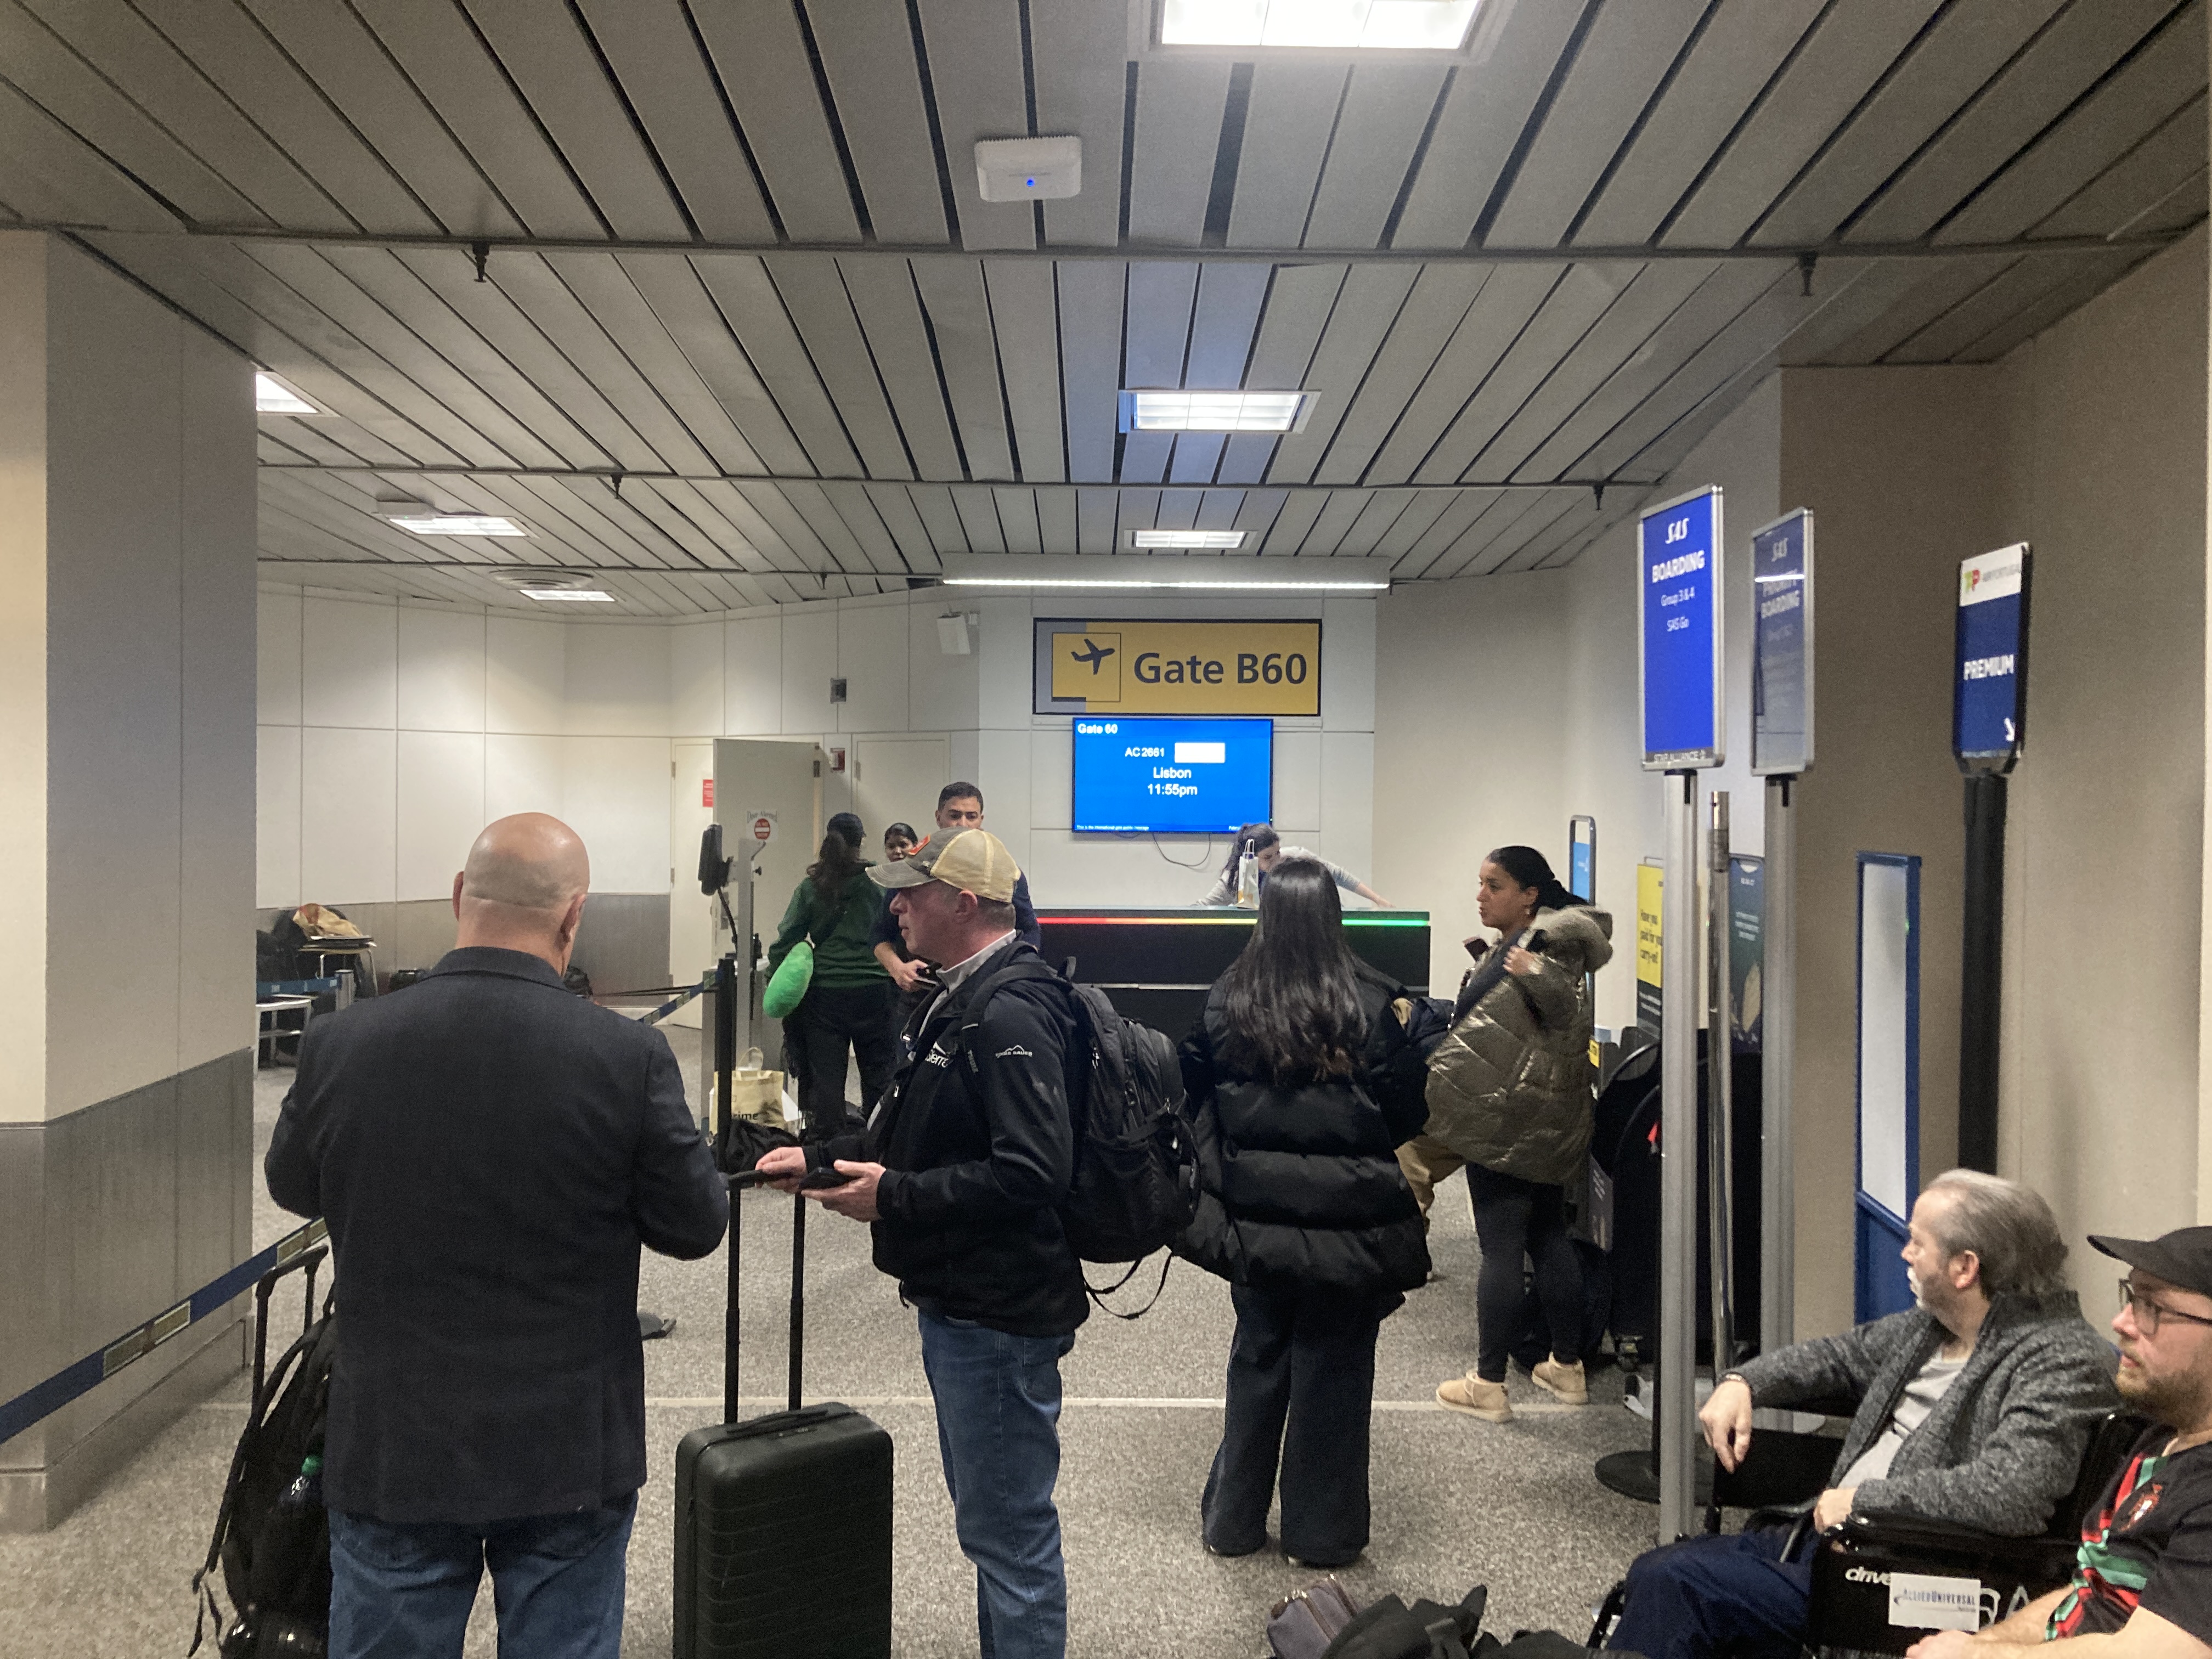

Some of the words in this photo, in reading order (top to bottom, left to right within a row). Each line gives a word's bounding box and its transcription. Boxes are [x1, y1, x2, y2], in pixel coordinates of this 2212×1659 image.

[1665, 518, 1689, 544] SAS
[1652, 550, 1705, 583] BOARDING
[1134, 652, 1224, 684] Gate
[1237, 653, 1307, 684] B60
[1963, 654, 2013, 680] PREMIUM
[1077, 723, 1103, 734] Gate
[1104, 723, 1118, 734] 60
[1153, 766, 1192, 778] Lisbon
[1147, 783, 1198, 798] 11:55pm
